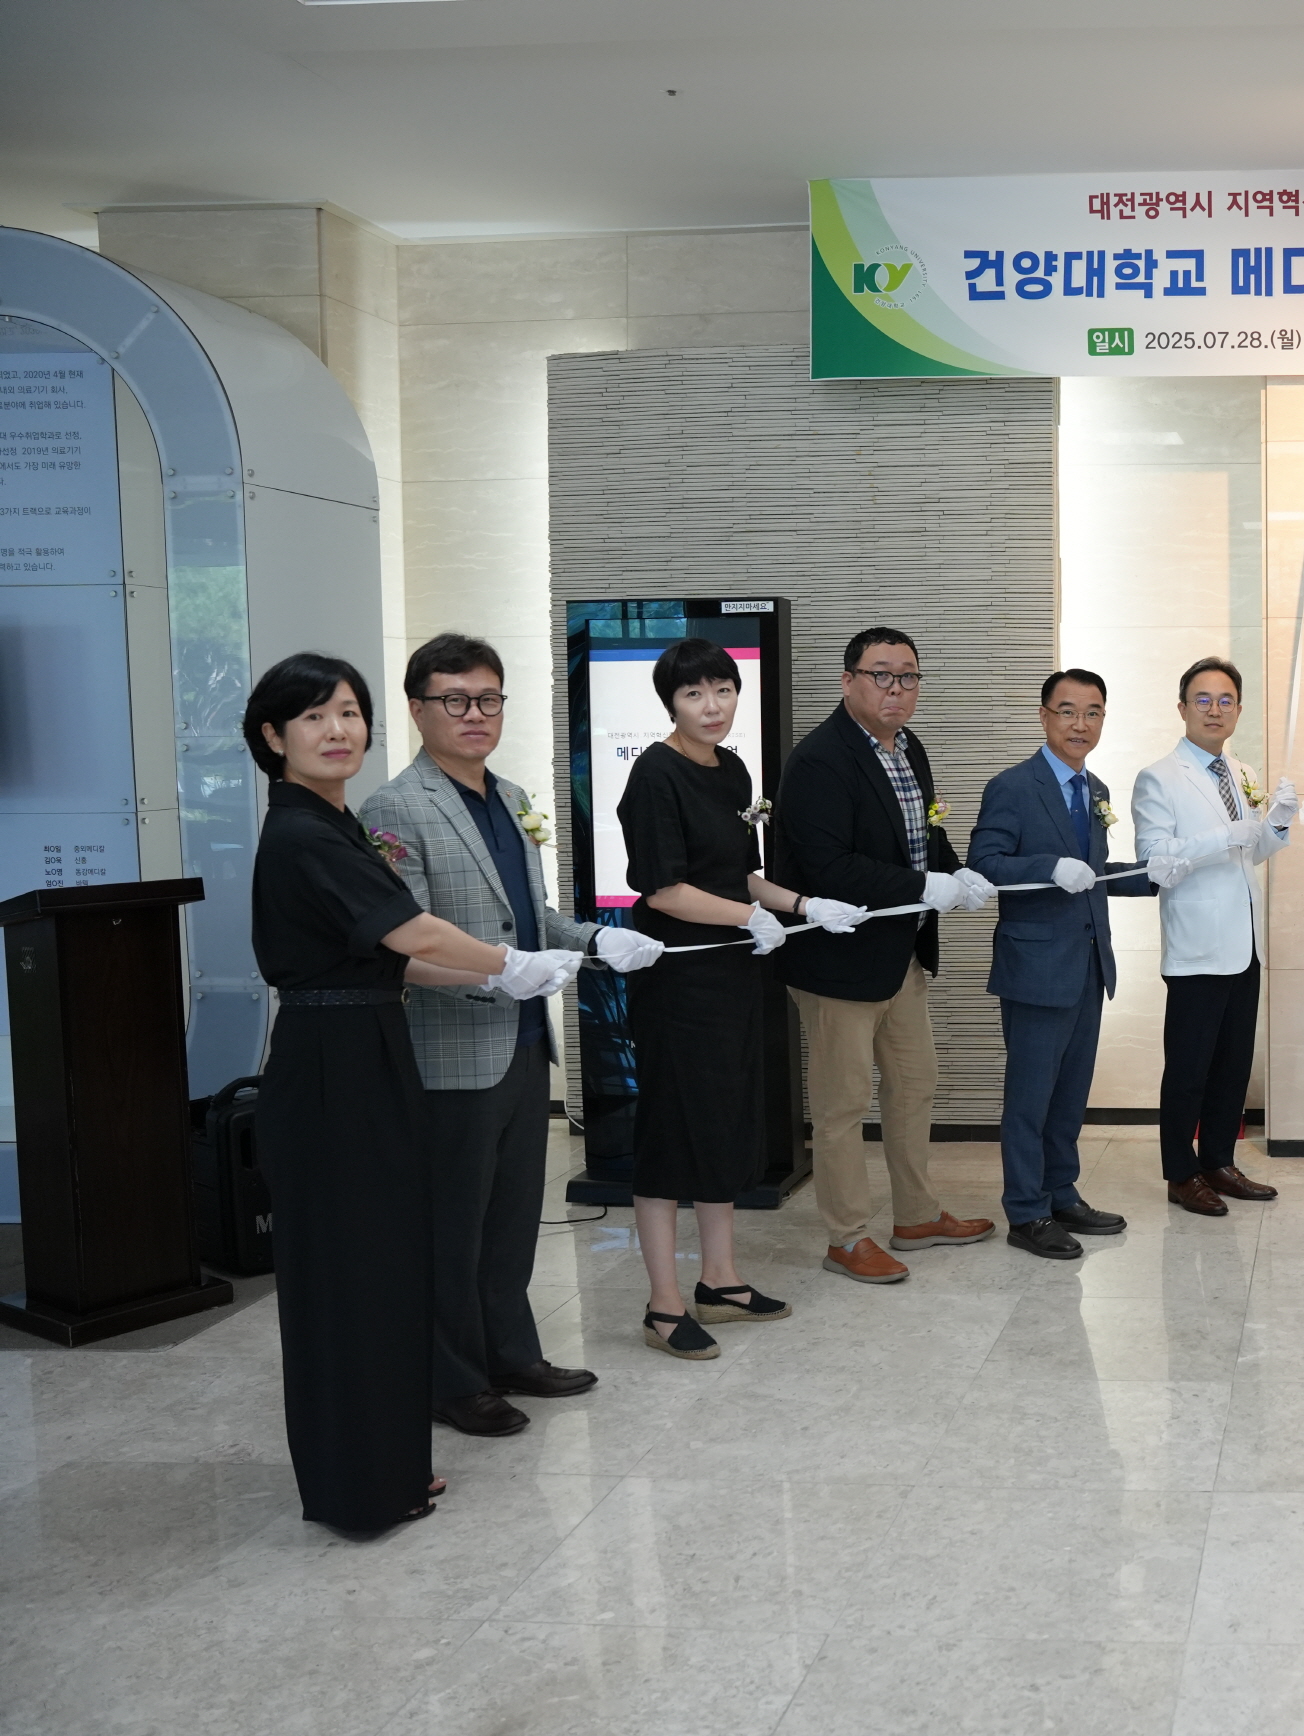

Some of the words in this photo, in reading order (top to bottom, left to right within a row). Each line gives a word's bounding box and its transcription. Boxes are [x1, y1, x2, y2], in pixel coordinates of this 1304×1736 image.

[1088, 190, 1213, 221] 대전광역시
[876, 245, 909, 256] KONYANG
[910, 250, 928, 288] UNIVERSITY
[963, 248, 1207, 302] 건양대학교
[1092, 331, 1129, 353] 일시
[1145, 329, 1302, 350] 2025.07.28.(월)
[23, 370, 51, 380] 2020년
[53, 370, 66, 380] 4월
[68, 370, 84, 380] 현재
[17, 386, 48, 394] 의료기기
[29, 400, 52, 410] 취업해
[54, 400, 86, 410] 있습니다.
[10, 431, 62, 440] 우수취업학과로
[22, 447, 49, 456] 2019년
[51, 447, 81, 456] 의료기기
[24, 461, 39, 471] 가장
[41, 461, 56, 471] 미래
[59, 461, 81, 471] 유망한
[22, 507, 52, 516] 트랙으로
[55, 507, 92, 516] 교육과정이
[18, 547, 33, 557] 적극
[35, 547, 65, 557] 활용하여
[23, 562, 56, 572] 있습니다.
